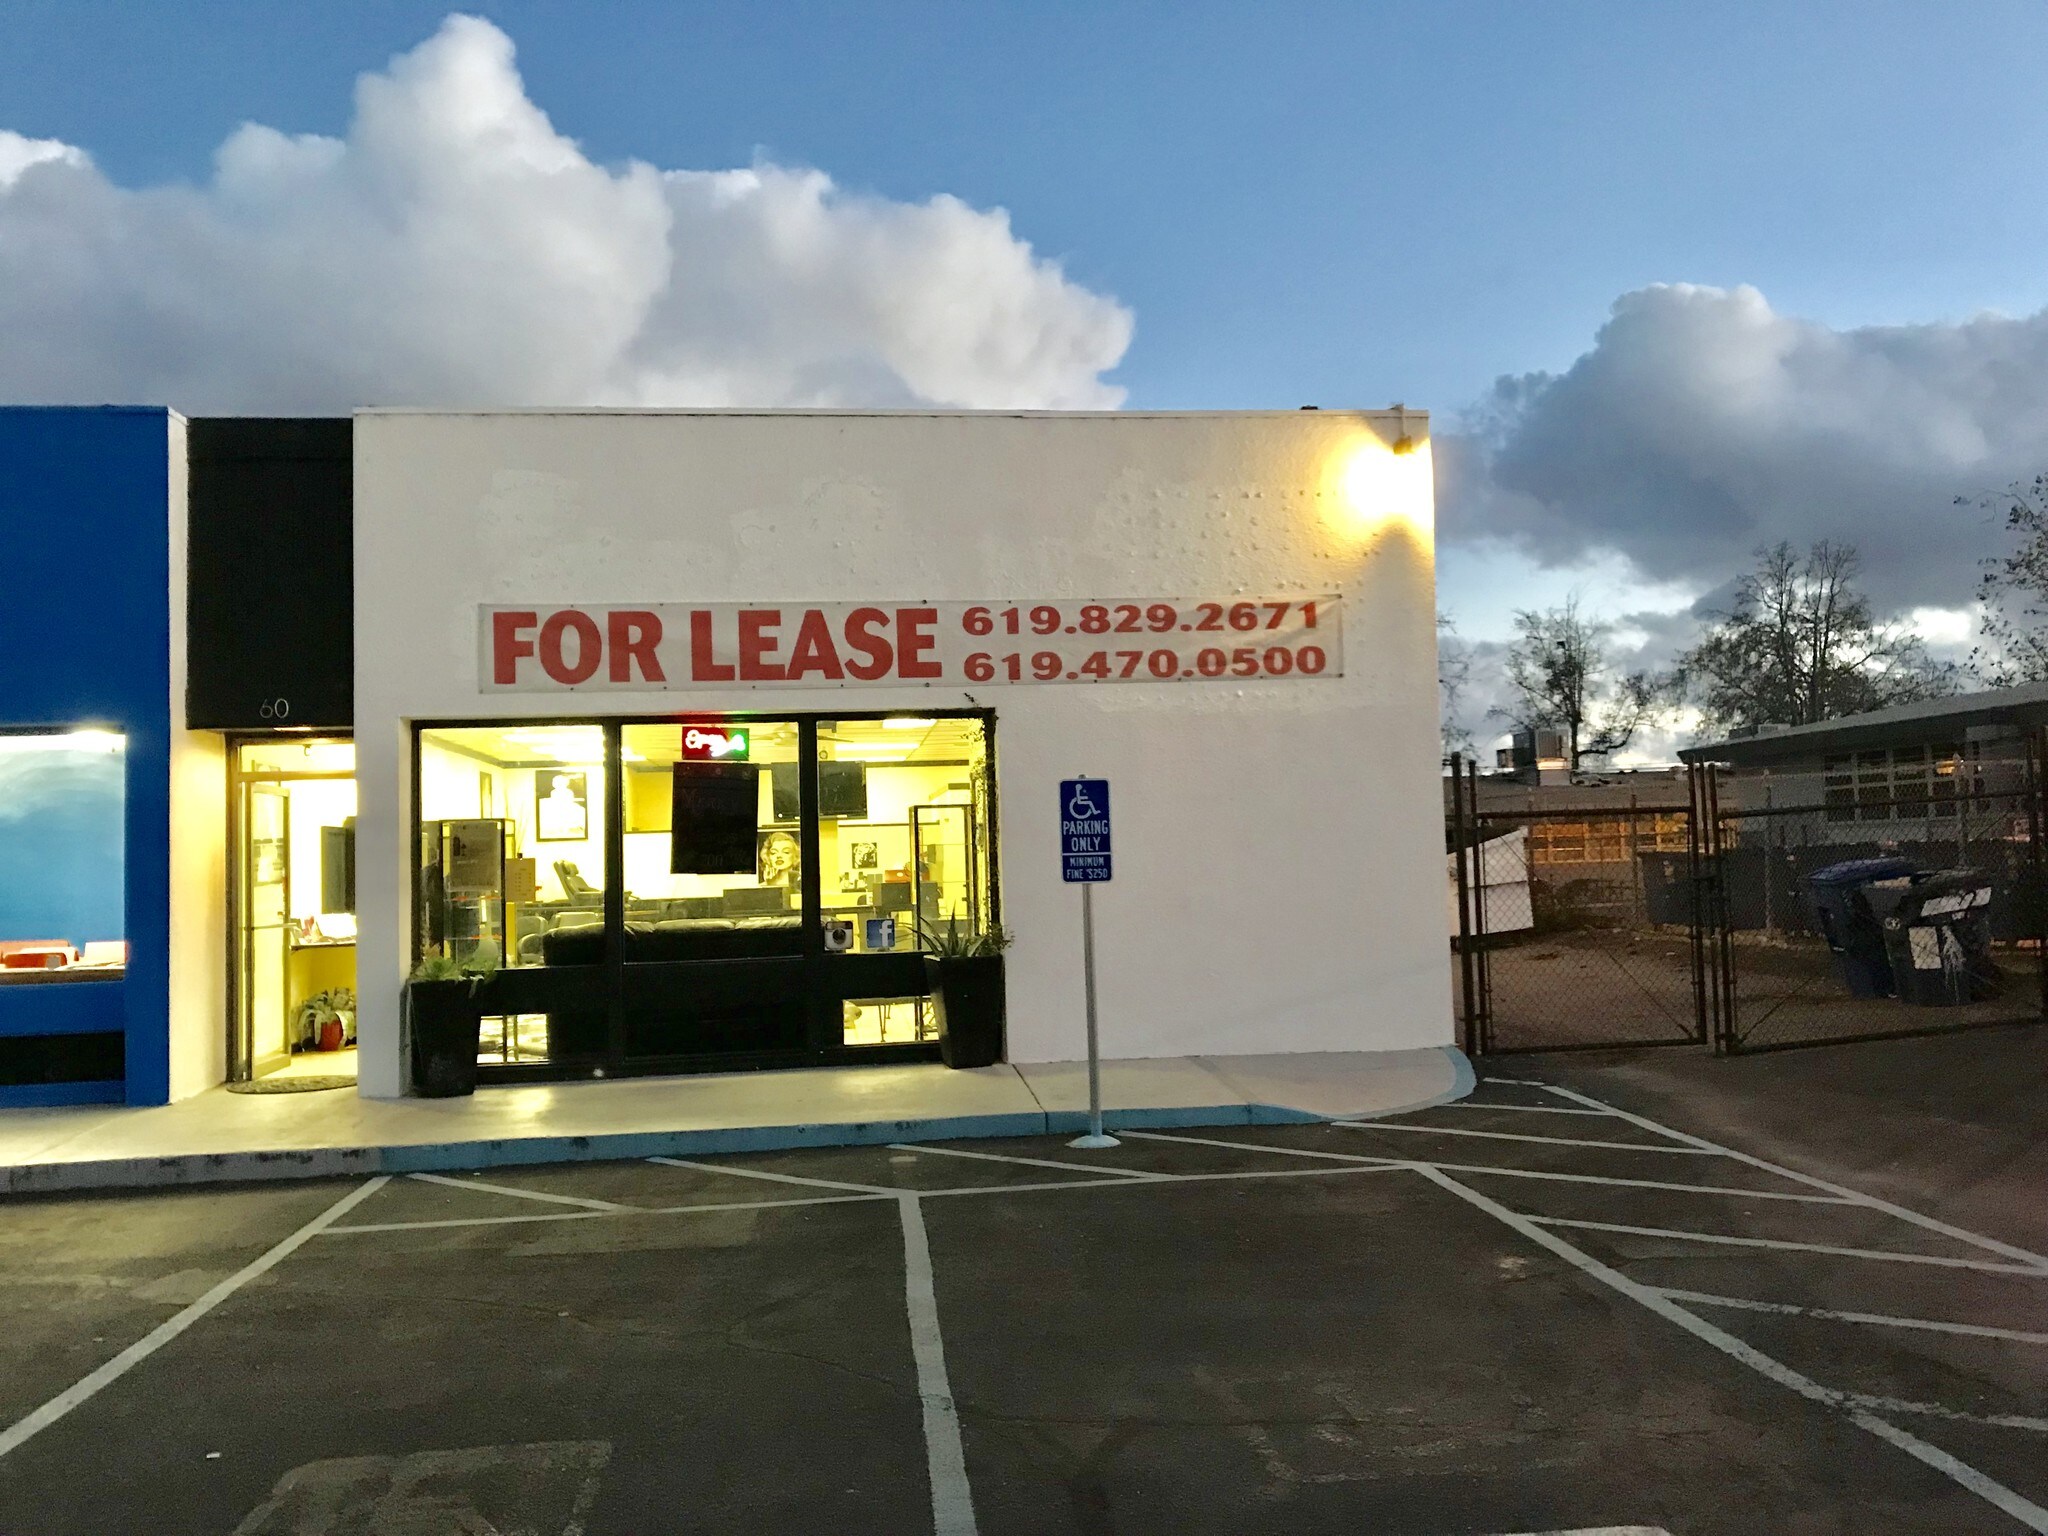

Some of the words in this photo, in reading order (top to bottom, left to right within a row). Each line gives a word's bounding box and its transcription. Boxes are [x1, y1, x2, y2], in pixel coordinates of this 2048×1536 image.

[962, 602, 1318, 636] 619.829.2671
[493, 609, 666, 685] FOR
[690, 607, 942, 681] LEASE
[963, 645, 1326, 682] 619.470.0500
[259, 698, 289, 719] 60
[1063, 820, 1108, 835] PARKING
[1071, 837, 1101, 851] ONLY
[1069, 857, 1104, 867] MINIMUM
[1066, 869, 1084, 879] FINE
